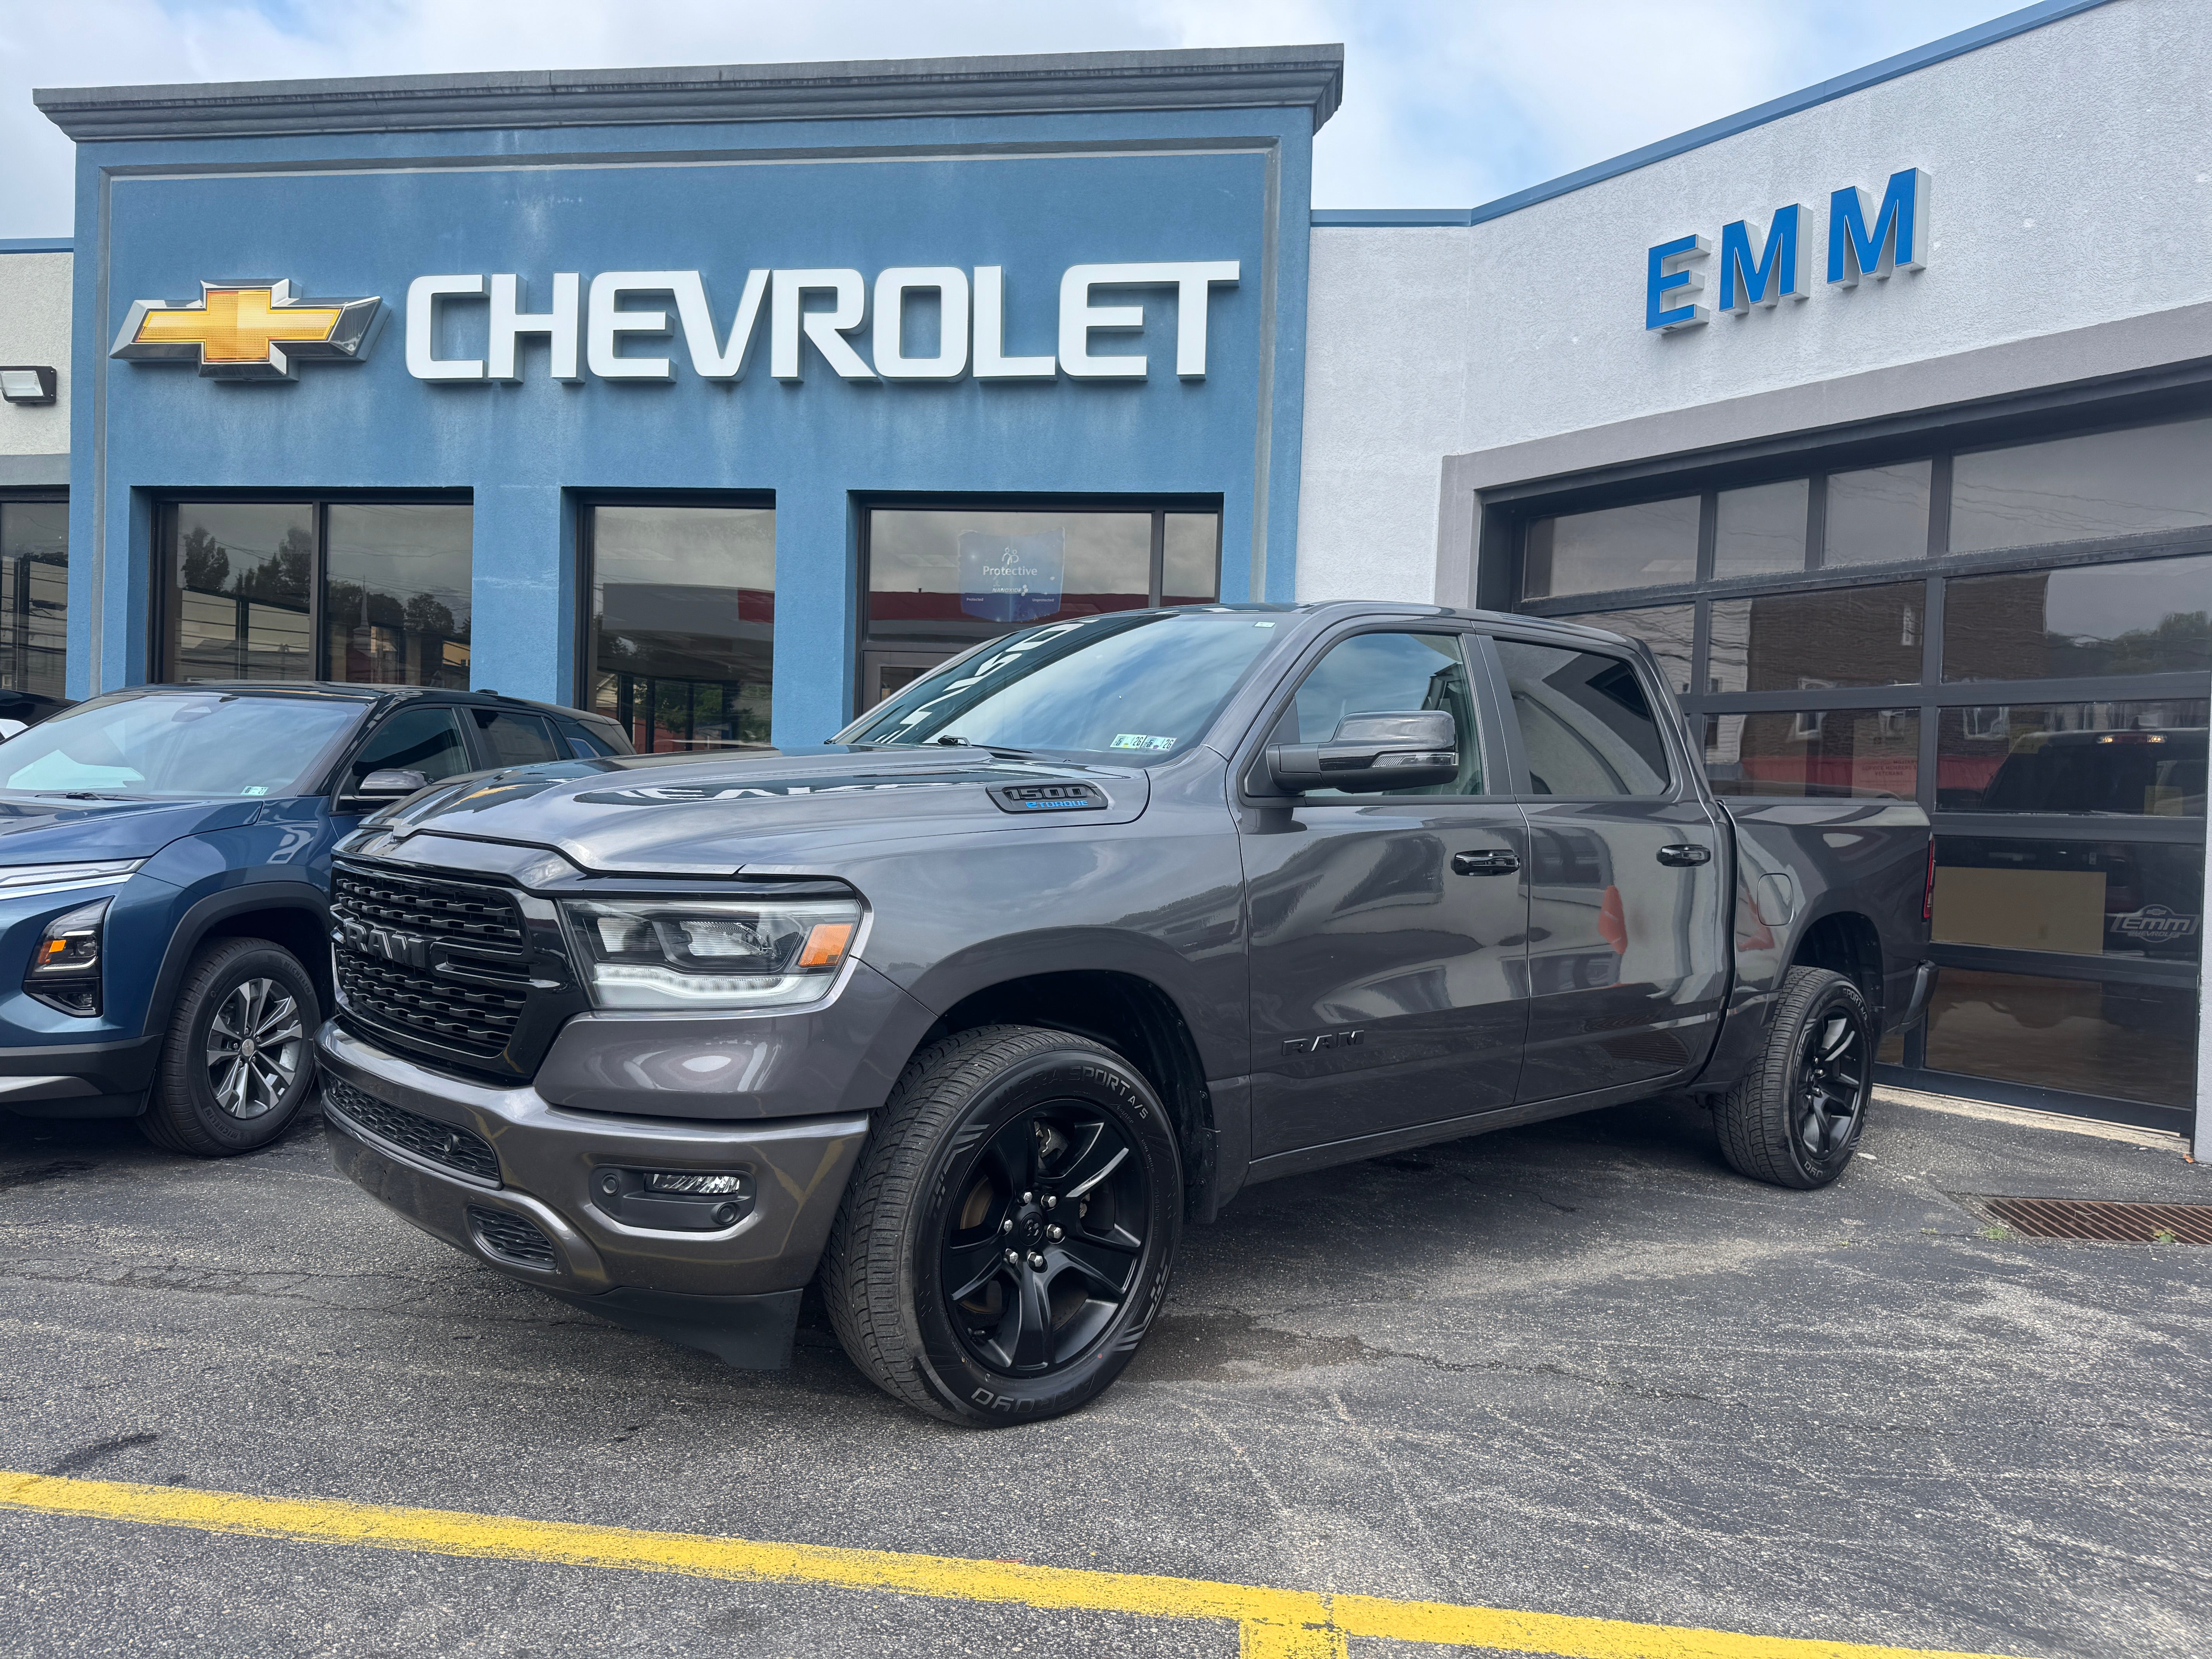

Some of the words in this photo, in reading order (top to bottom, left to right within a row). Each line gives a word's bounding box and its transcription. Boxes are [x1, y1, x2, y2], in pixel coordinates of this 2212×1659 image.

[1646, 167, 1927, 332] EMM
[405, 260, 1240, 382] CHEVROLET
[982, 565, 1037, 576] Protective
[1132, 737, 1144, 746] 26
[1162, 739, 1174, 749] 26
[1005, 787, 1087, 800] 1500
[345, 922, 427, 968] RAM
[283, 961, 311, 993] MICHELIN
[1282, 1029, 1364, 1056] RAM
[1068, 1066, 1130, 1096] SPORT
[1127, 1095, 1148, 1119] A/S
[205, 1108, 239, 1139] MICHELIN
